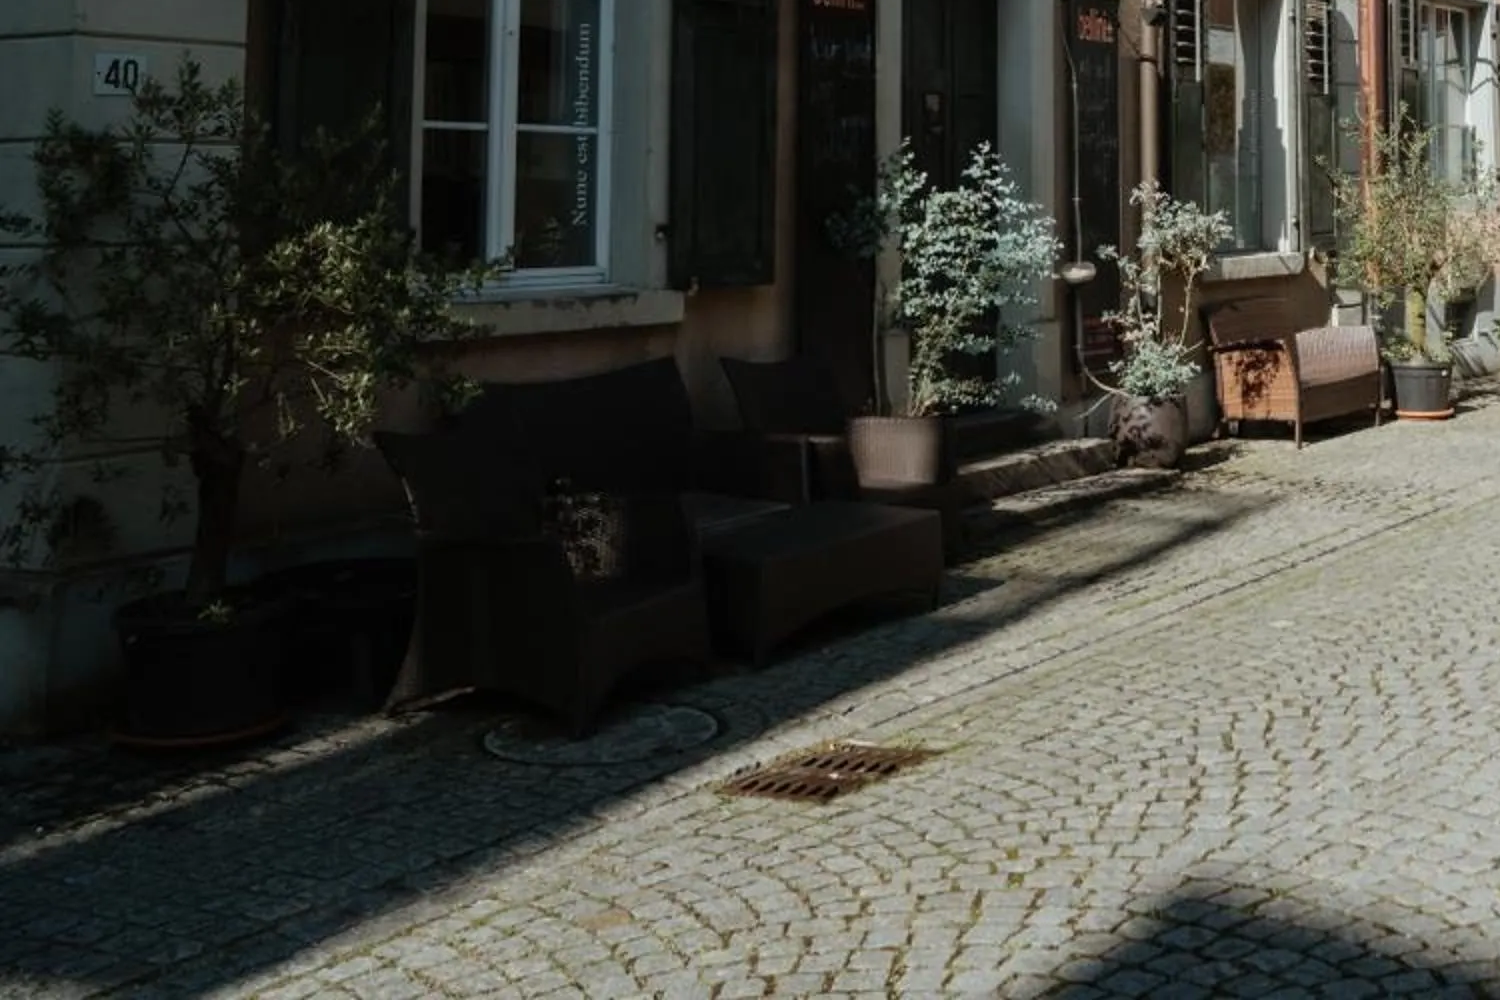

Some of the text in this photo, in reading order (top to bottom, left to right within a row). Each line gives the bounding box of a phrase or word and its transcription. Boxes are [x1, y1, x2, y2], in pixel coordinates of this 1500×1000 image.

[104, 58, 139, 90] 40
[572, 23, 591, 126] bibendum
[570, 169, 589, 227] Nunc
